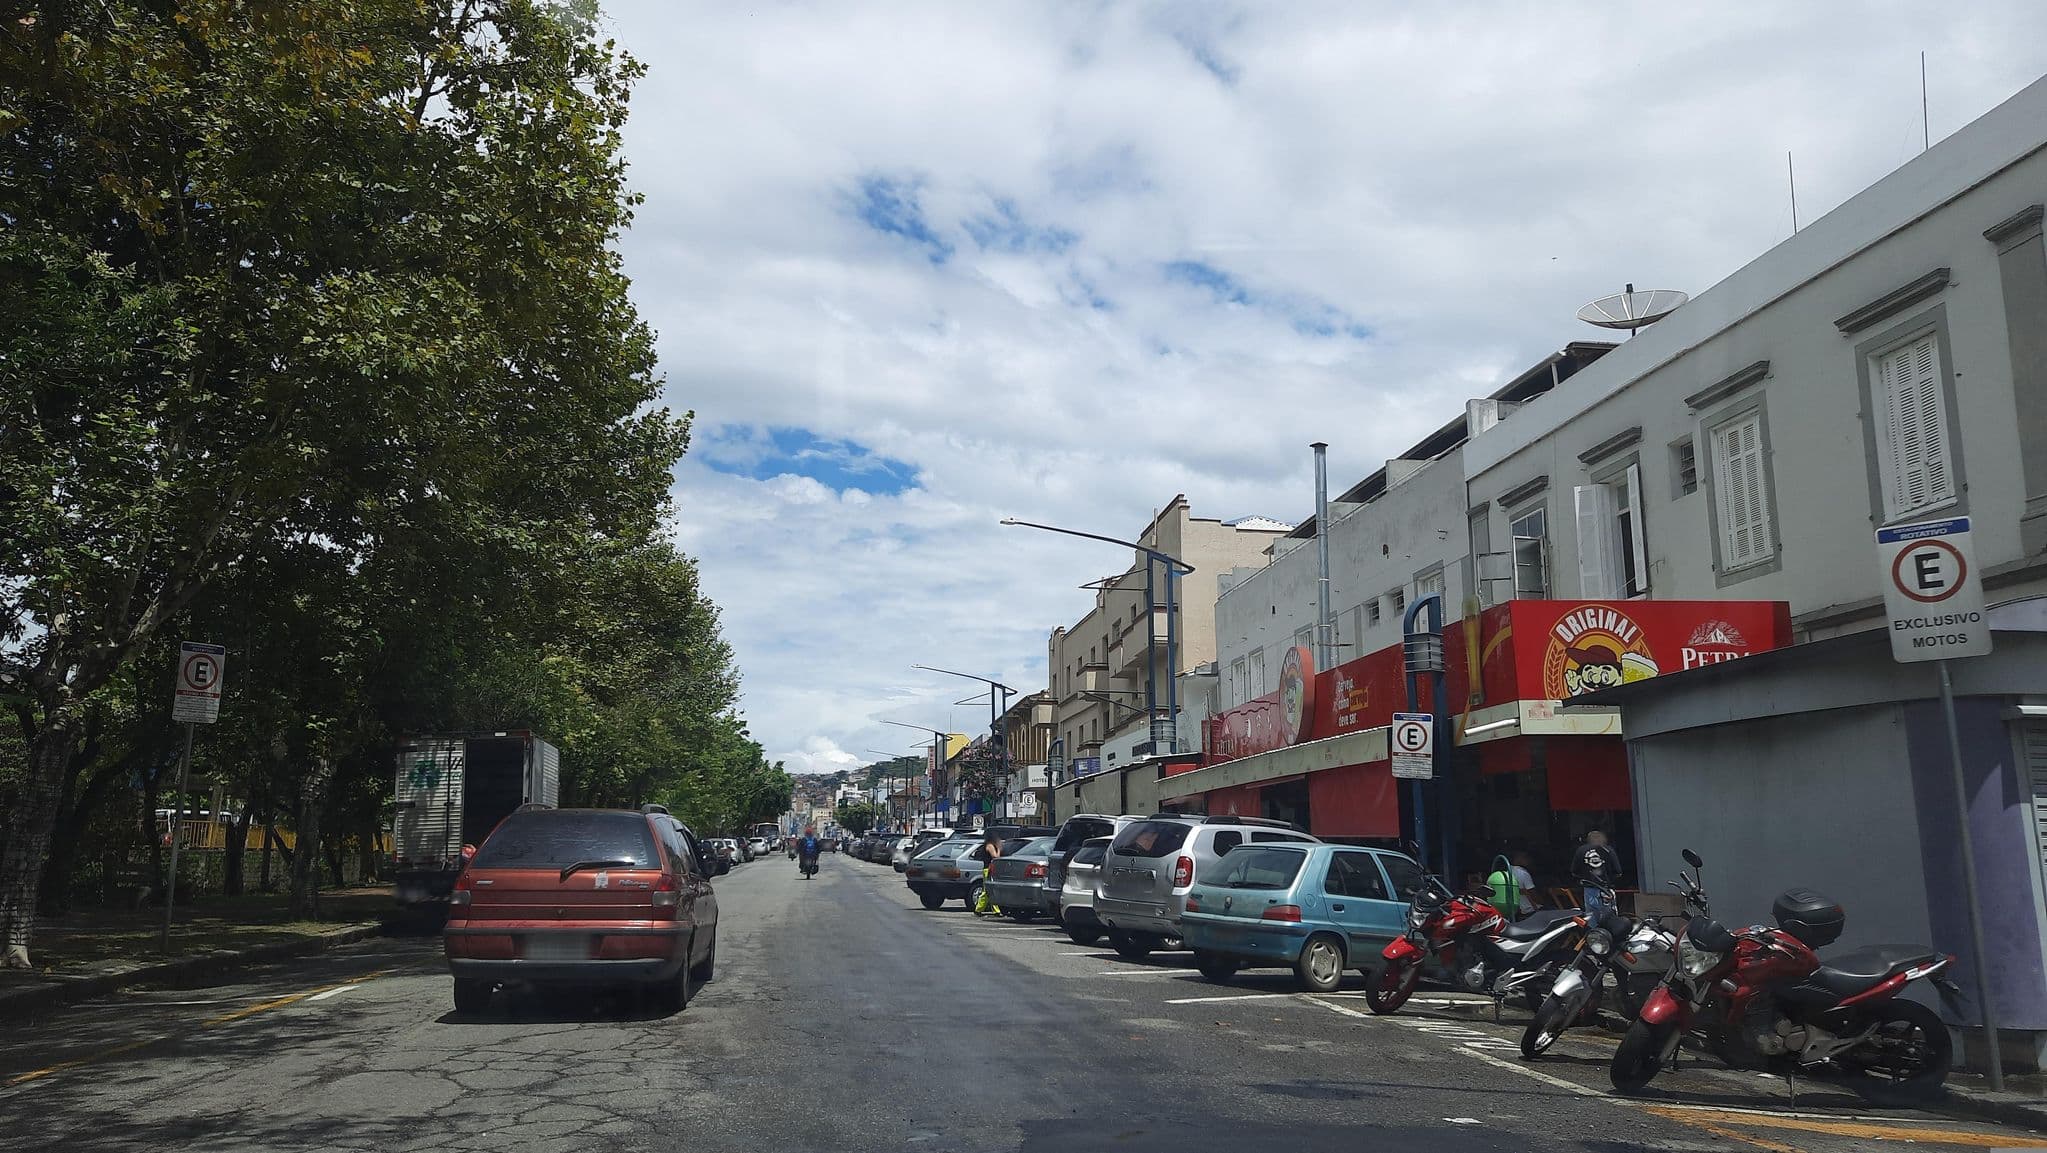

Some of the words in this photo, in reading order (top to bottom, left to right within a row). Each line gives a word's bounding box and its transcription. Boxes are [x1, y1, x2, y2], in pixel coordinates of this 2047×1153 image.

[1900, 528, 1948, 540] ROTATIVO
[1914, 552, 1945, 590] E
[1555, 608, 1638, 643] ORIGINAL
[1894, 612, 1980, 631] EXCLUSIVO
[1913, 633, 1968, 648] MOTOS
[1681, 647, 1750, 671] PET
[194, 661, 208, 683] E
[1407, 728, 1418, 746] E
